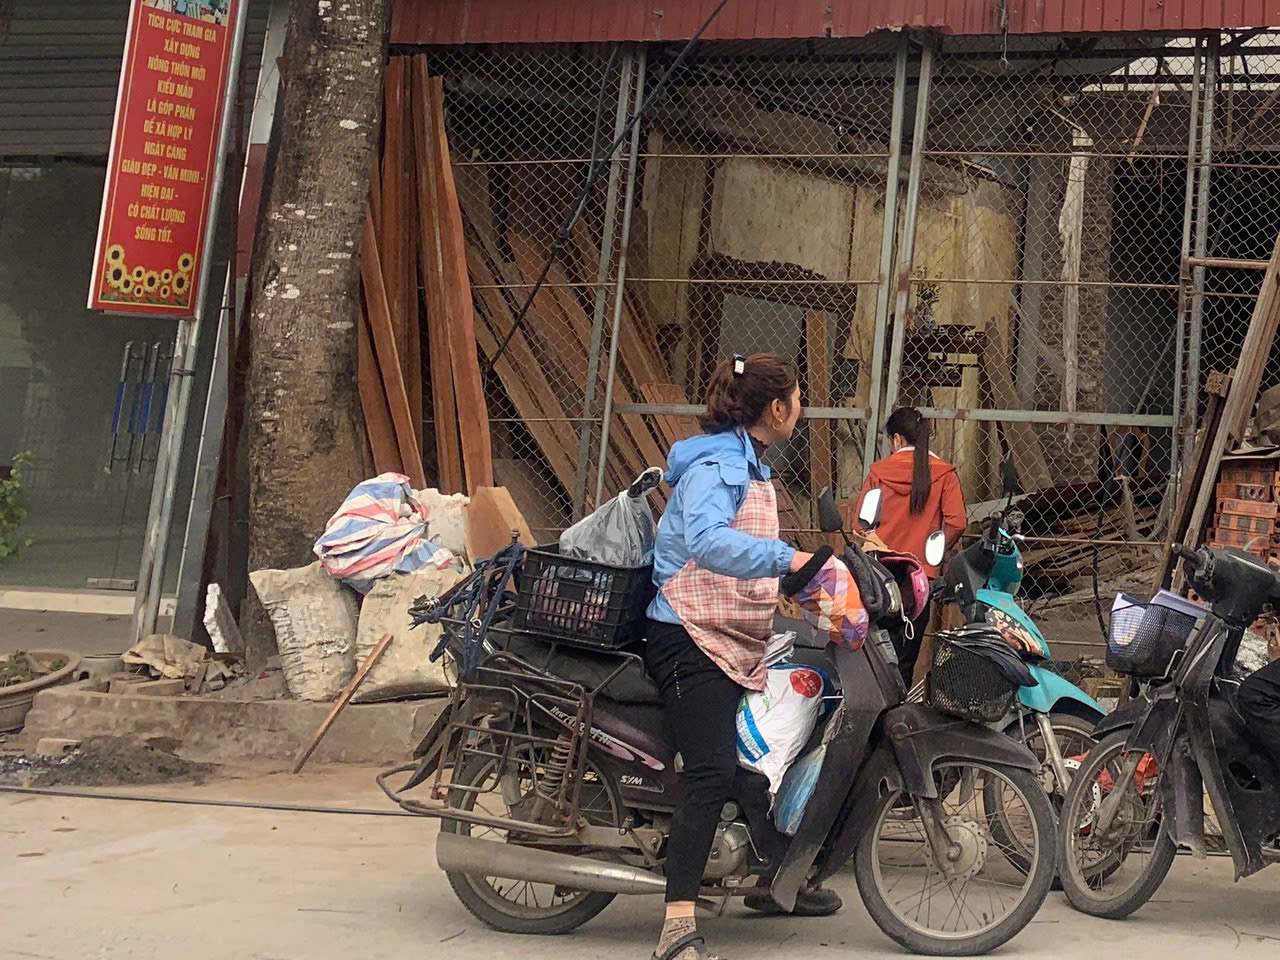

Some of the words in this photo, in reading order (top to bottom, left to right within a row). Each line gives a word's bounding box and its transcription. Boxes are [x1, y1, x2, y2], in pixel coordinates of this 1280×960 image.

[148, 12, 165, 29] TÍCH
[166, 18, 181, 34] CỰC
[183, 22, 203, 39] THAM
[204, 28, 216, 43] GIA
[163, 37, 179, 54] XÂY
[180, 43, 200, 59] DỰNG
[147, 55, 169, 73] NÔNG
[171, 61, 190, 77] THÔN
[191, 64, 206, 81] MỚI
[158, 100, 174, 116] GÓP
[144, 140, 165, 157] NGÀY
[179, 168, 200, 184] MINH
[141, 182, 160, 201] HIỆN
[140, 202, 160, 220] CHẤT
[135, 222, 156, 241] SỐNG
[620, 775, 643, 785] SYM
